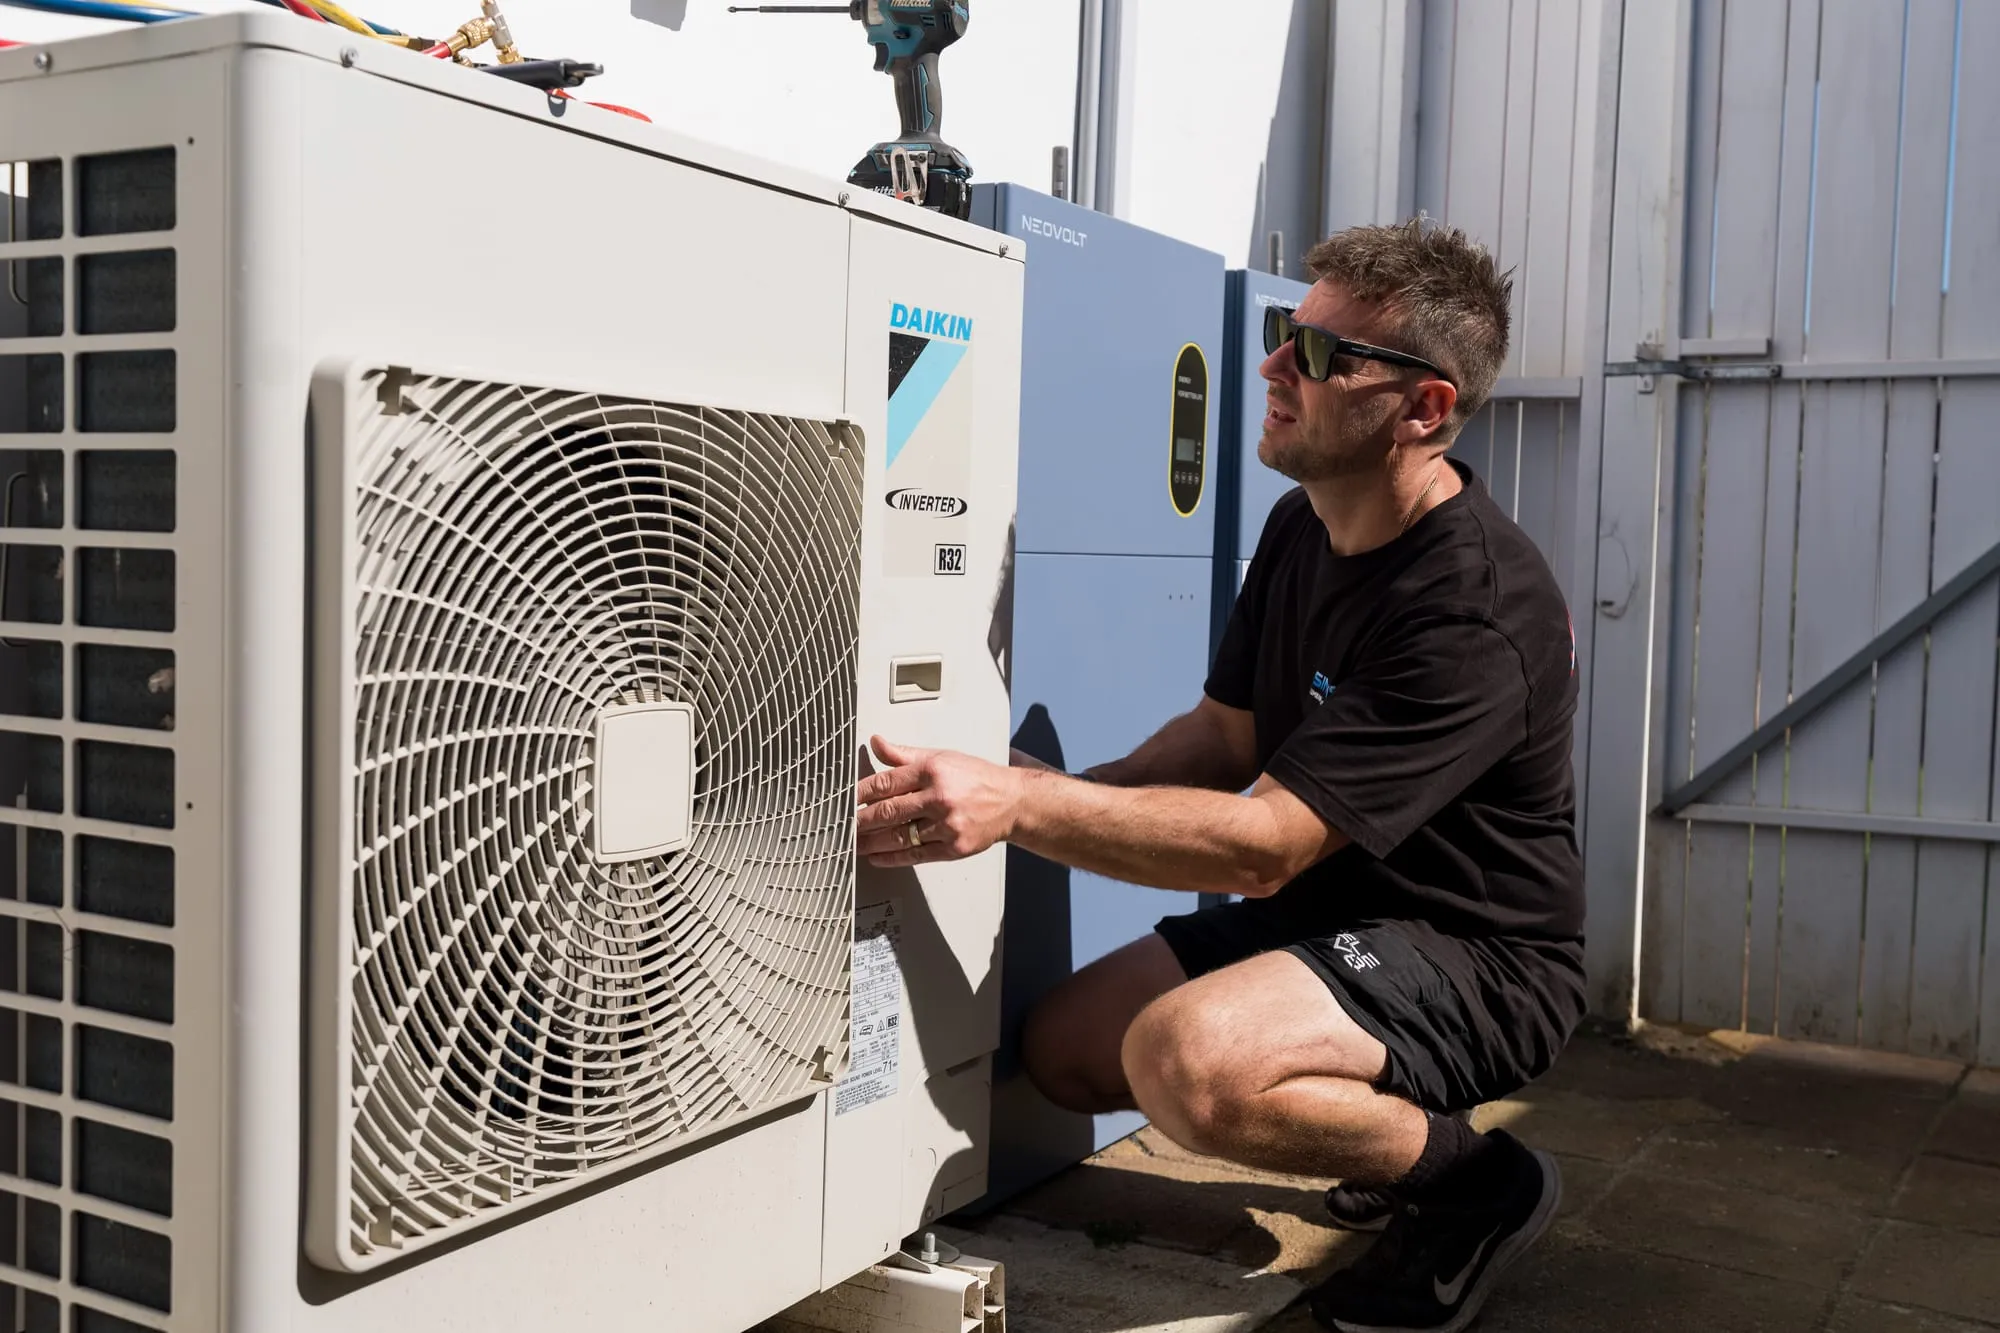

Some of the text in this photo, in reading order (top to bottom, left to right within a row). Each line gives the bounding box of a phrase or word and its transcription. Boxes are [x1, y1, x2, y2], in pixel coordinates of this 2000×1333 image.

[1021, 213, 1088, 248] NEOVOLT
[890, 302, 973, 342] DAIKIN
[899, 493, 956, 513] INVERTER
[938, 547, 962, 571] R32
[882, 1059, 892, 1073] 71
